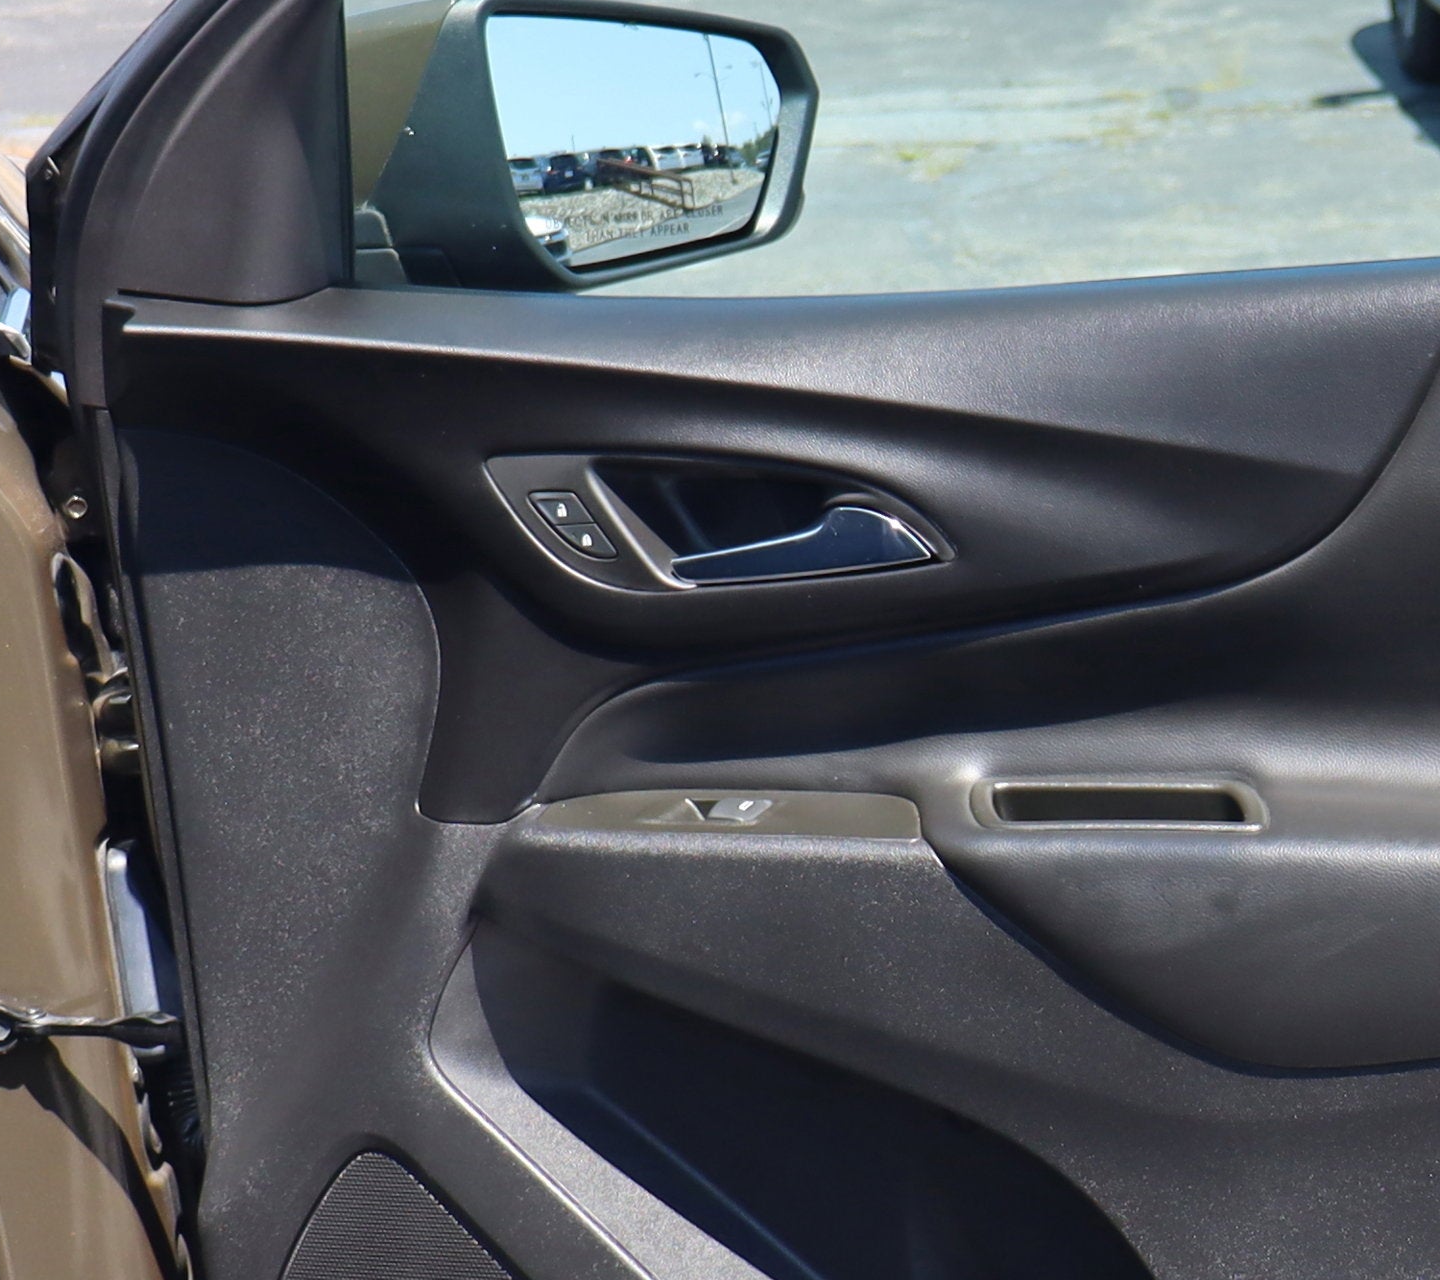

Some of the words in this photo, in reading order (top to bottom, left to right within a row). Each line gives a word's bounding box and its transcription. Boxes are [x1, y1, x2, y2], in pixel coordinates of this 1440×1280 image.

[661, 208, 678, 219] ARE
[586, 228, 614, 242] THAN
[650, 222, 690, 237] APPEAR
